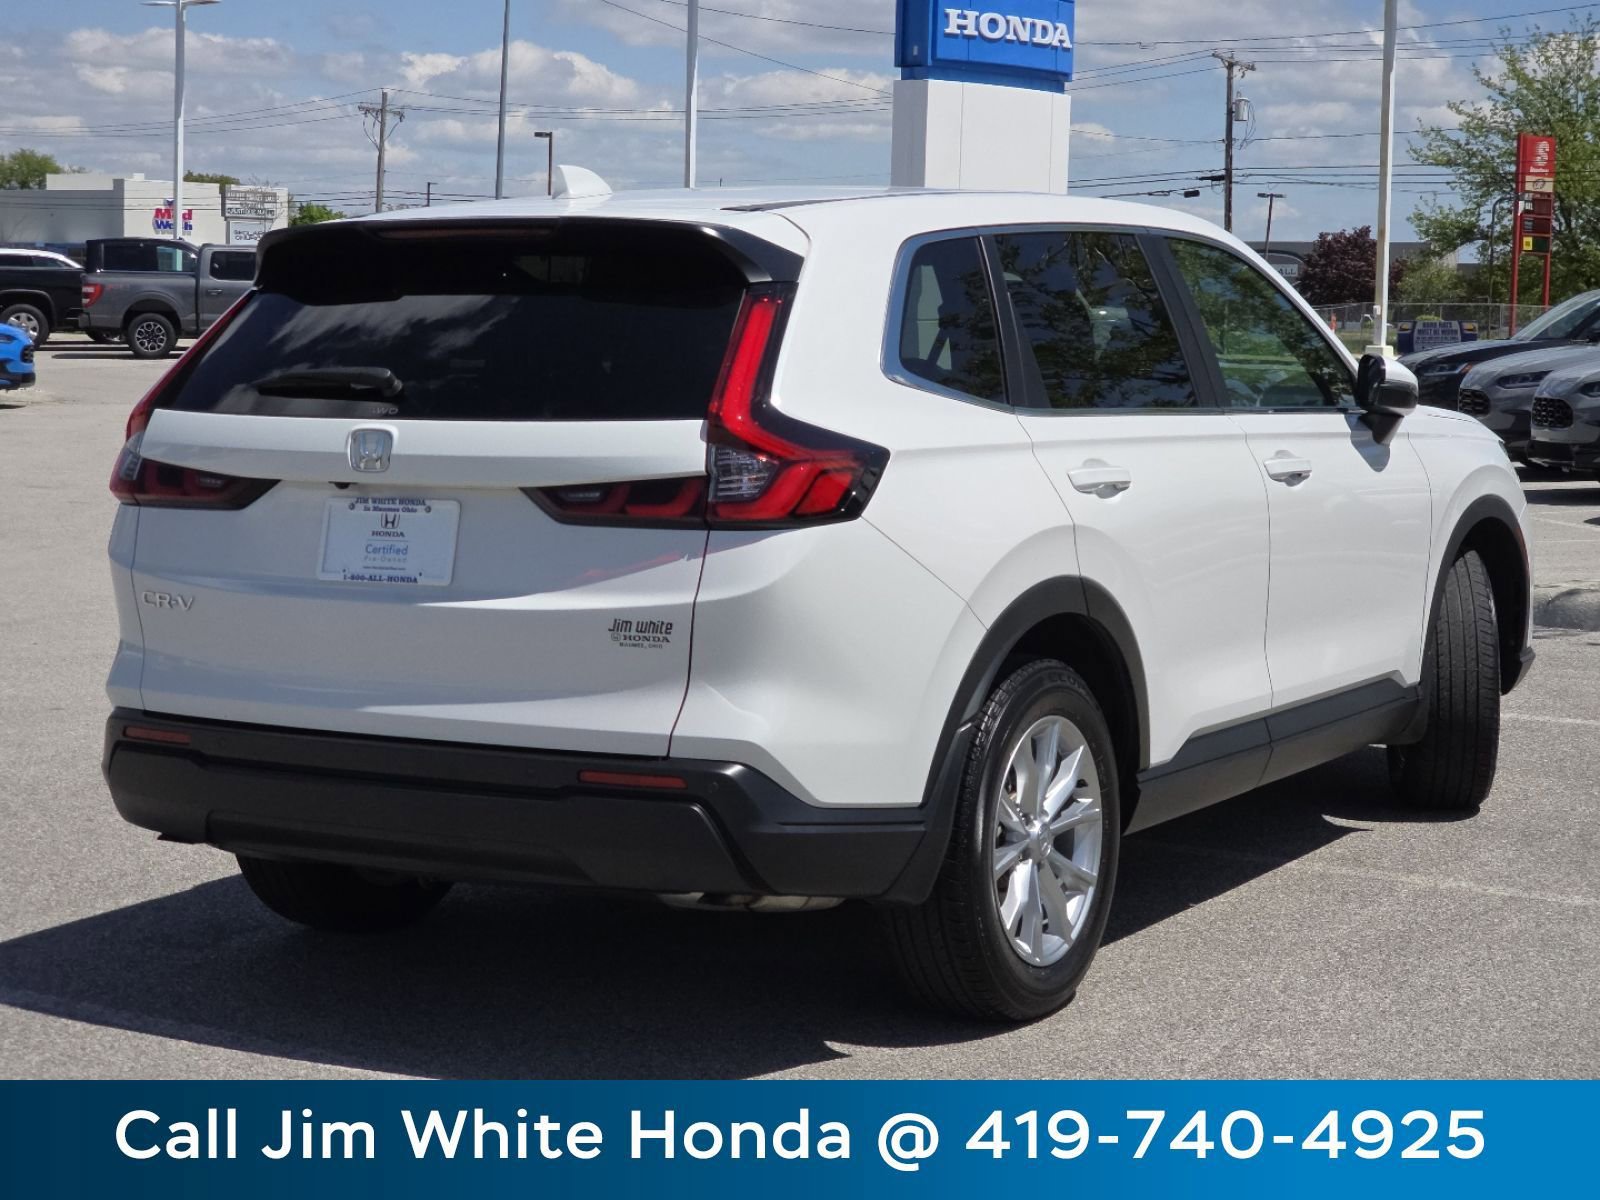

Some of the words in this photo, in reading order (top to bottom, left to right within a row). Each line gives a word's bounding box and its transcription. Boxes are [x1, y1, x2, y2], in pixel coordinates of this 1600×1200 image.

[944, 8, 1073, 49] HONDA
[155, 208, 193, 220] Md
[371, 497, 397, 505] WHITE
[398, 498, 426, 506] HONDA
[371, 530, 405, 538] HONDA
[365, 543, 409, 556] Certified
[608, 618, 633, 633] Jim
[622, 634, 671, 643] HONDA
